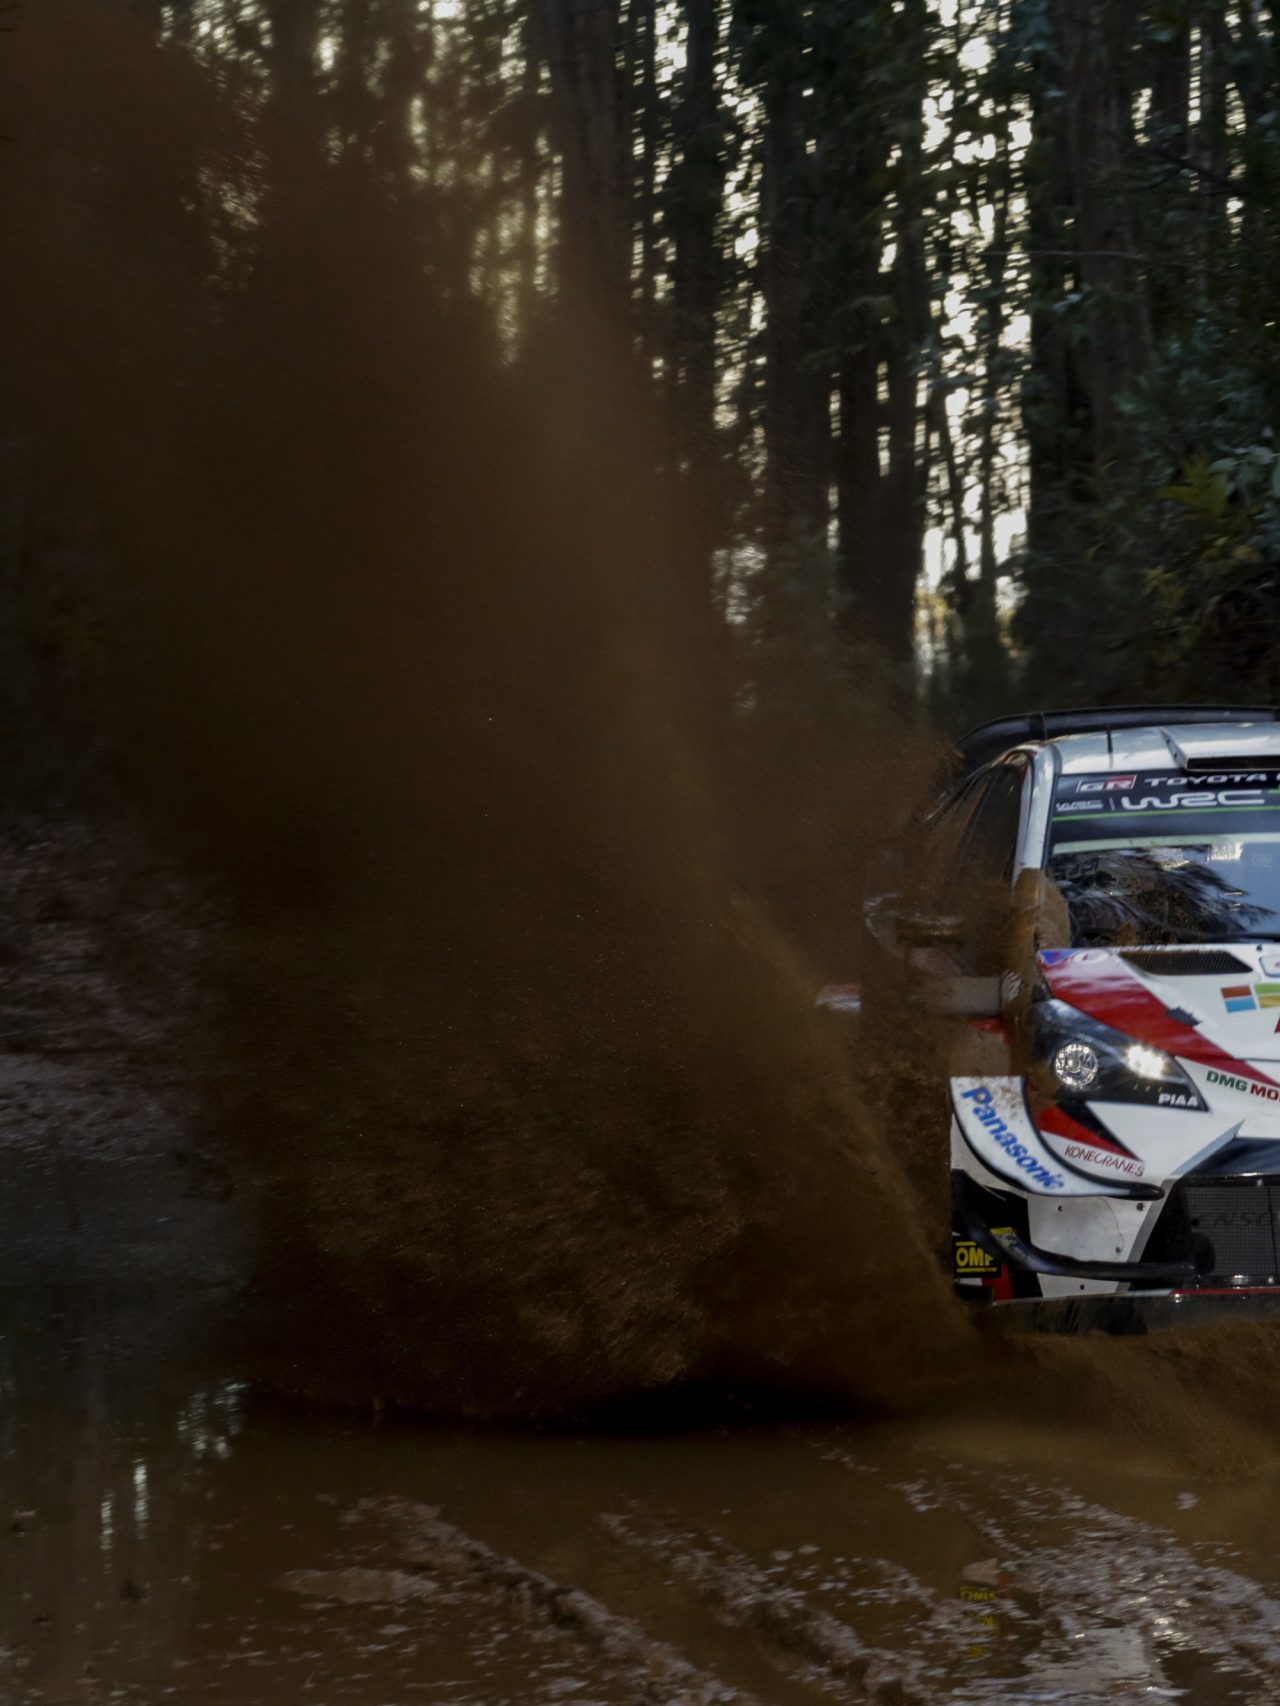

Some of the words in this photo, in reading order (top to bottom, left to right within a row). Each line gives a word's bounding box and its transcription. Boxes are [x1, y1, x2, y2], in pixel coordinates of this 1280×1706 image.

[1079, 777, 1133, 791] GR
[1145, 773, 1267, 787] TOYOTA
[1206, 1069, 1248, 1092] DMG
[1158, 1093, 1199, 1109] PIAA
[961, 1086, 1065, 1191] Panasonic
[1063, 1144, 1146, 1177] KONECRANES
